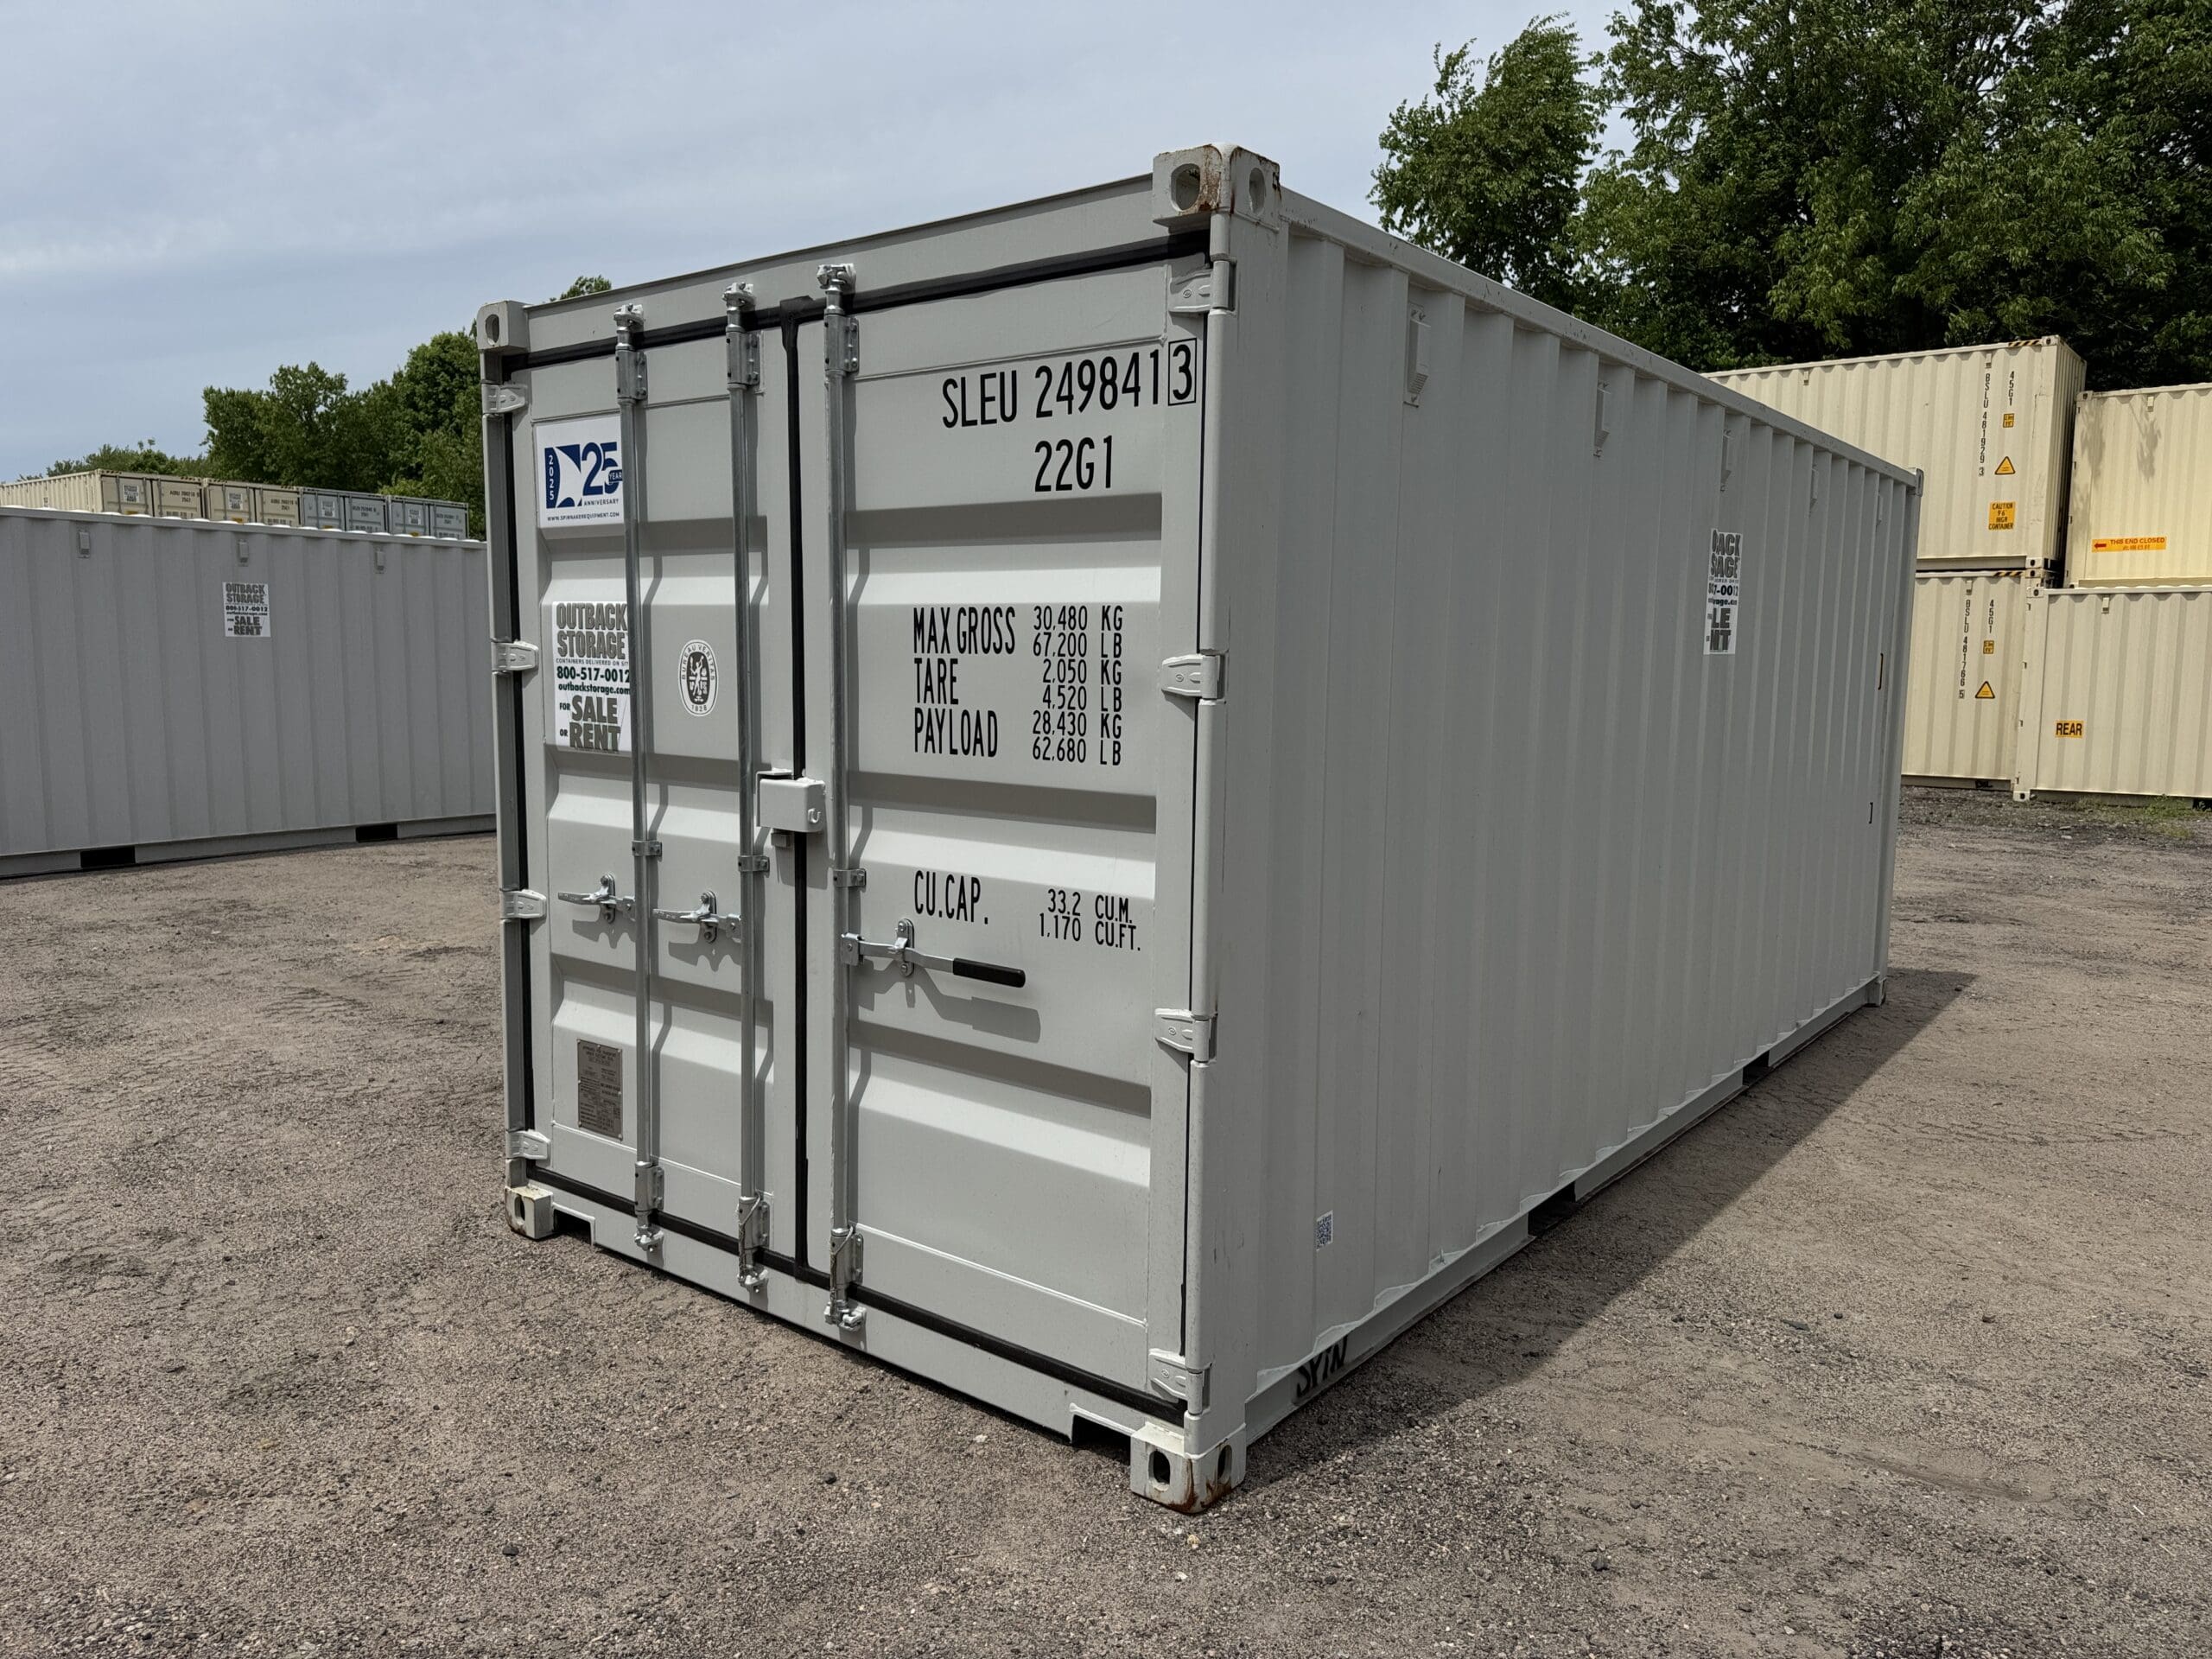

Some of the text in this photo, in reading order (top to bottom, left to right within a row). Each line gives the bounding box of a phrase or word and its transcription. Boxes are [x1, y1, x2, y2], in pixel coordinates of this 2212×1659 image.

[942, 369, 1017, 428] SLEU
[582, 442, 620, 495] 25
[1034, 435, 1112, 493] 22G1
[226, 583, 265, 594] OUTBACK
[226, 594, 264, 603] STORAGE
[234, 626, 262, 635] RENT
[235, 616, 260, 625] SALE
[556, 602, 627, 631] OUTBACK
[913, 607, 950, 654] MAX
[957, 607, 1015, 654] GROSS
[1101, 605, 1123, 632] KG
[557, 630, 626, 659] STORAGE
[1101, 632, 1122, 658] LB
[557, 665, 629, 683] 800-517-0012
[914, 658, 959, 705] TARE
[1101, 659, 1122, 685] KG
[558, 682, 630, 695] outbackstorage.com
[1101, 686, 1122, 712] LB
[572, 695, 618, 723] SALE
[569, 722, 621, 752] RENT
[914, 707, 998, 757] PAYLOAD
[1100, 713, 1122, 739] KG
[2056, 722, 2082, 735] REAR
[1100, 739, 1122, 766] LB
[1047, 888, 1081, 917] 33.2
[1095, 893, 1133, 924] CU.M.
[1095, 920, 1141, 951] CU.FT.
